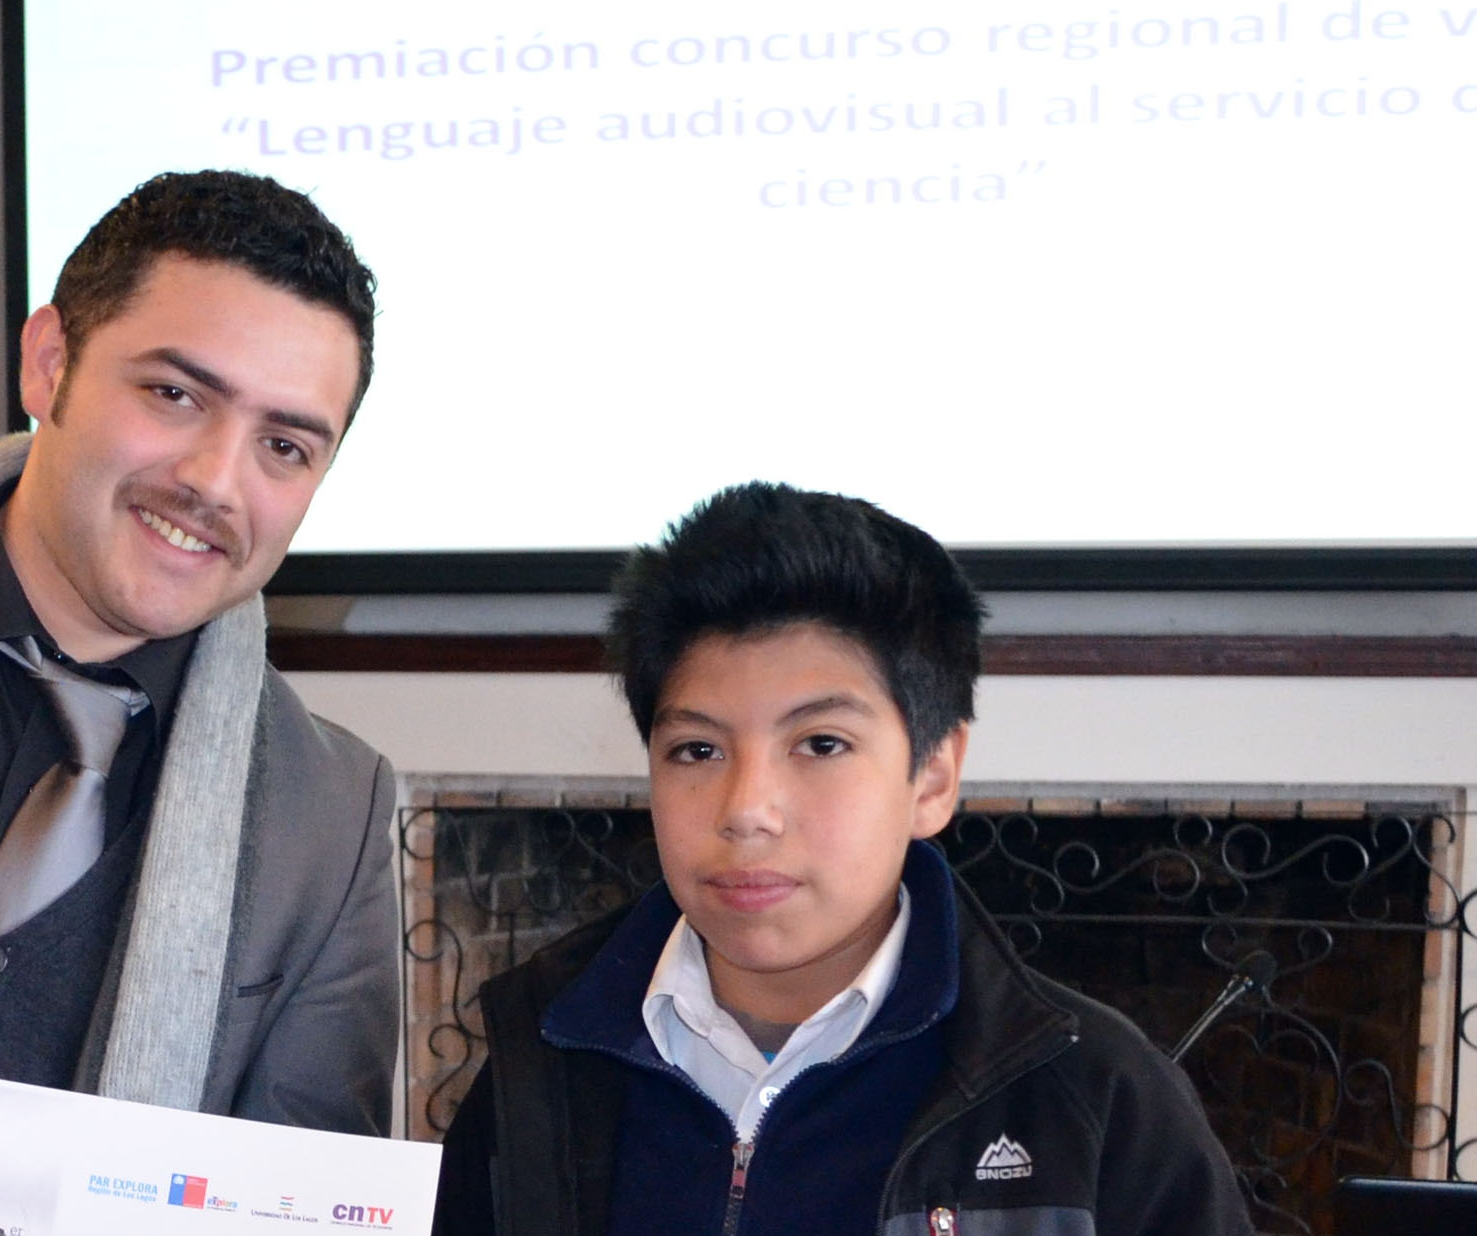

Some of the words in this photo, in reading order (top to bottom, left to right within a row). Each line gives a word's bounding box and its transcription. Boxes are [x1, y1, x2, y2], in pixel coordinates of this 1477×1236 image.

[211, 32, 600, 87] Premiación
[629, 25, 952, 68] concurso
[986, 1, 1289, 61] regional
[1321, 0, 1411, 42] de
[596, 86, 1009, 142] audiovisual
[1043, 83, 1101, 126] al
[1130, 75, 1422, 124] servicio
[89, 1174, 109, 1187] PAR
[113, 1177, 158, 1195] EXPLORA
